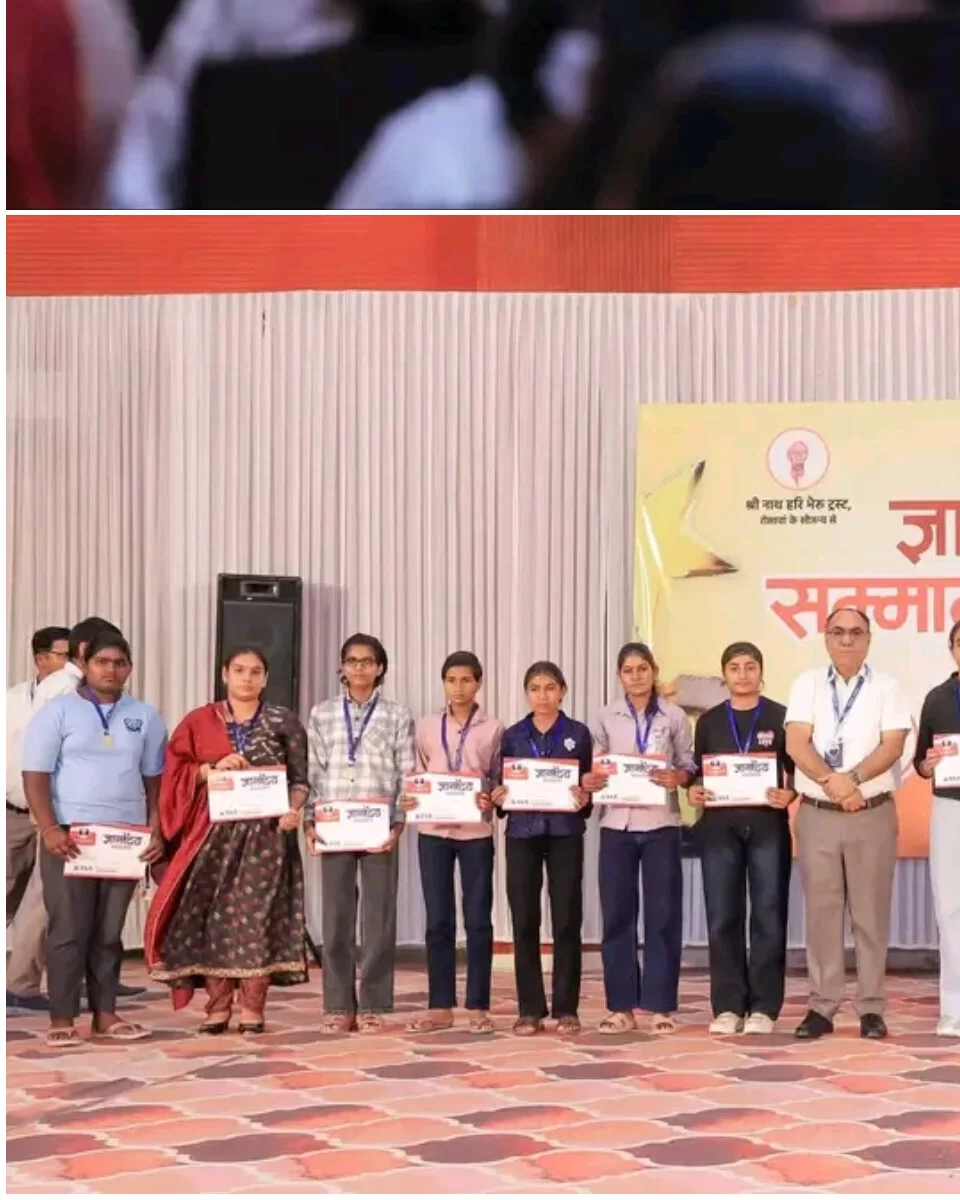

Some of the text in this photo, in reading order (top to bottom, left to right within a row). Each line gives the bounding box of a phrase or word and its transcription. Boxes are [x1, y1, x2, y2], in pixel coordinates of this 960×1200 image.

[745, 496, 760, 511] श्री
[762, 499, 783, 510] नाथ
[785, 495, 803, 511] हरि
